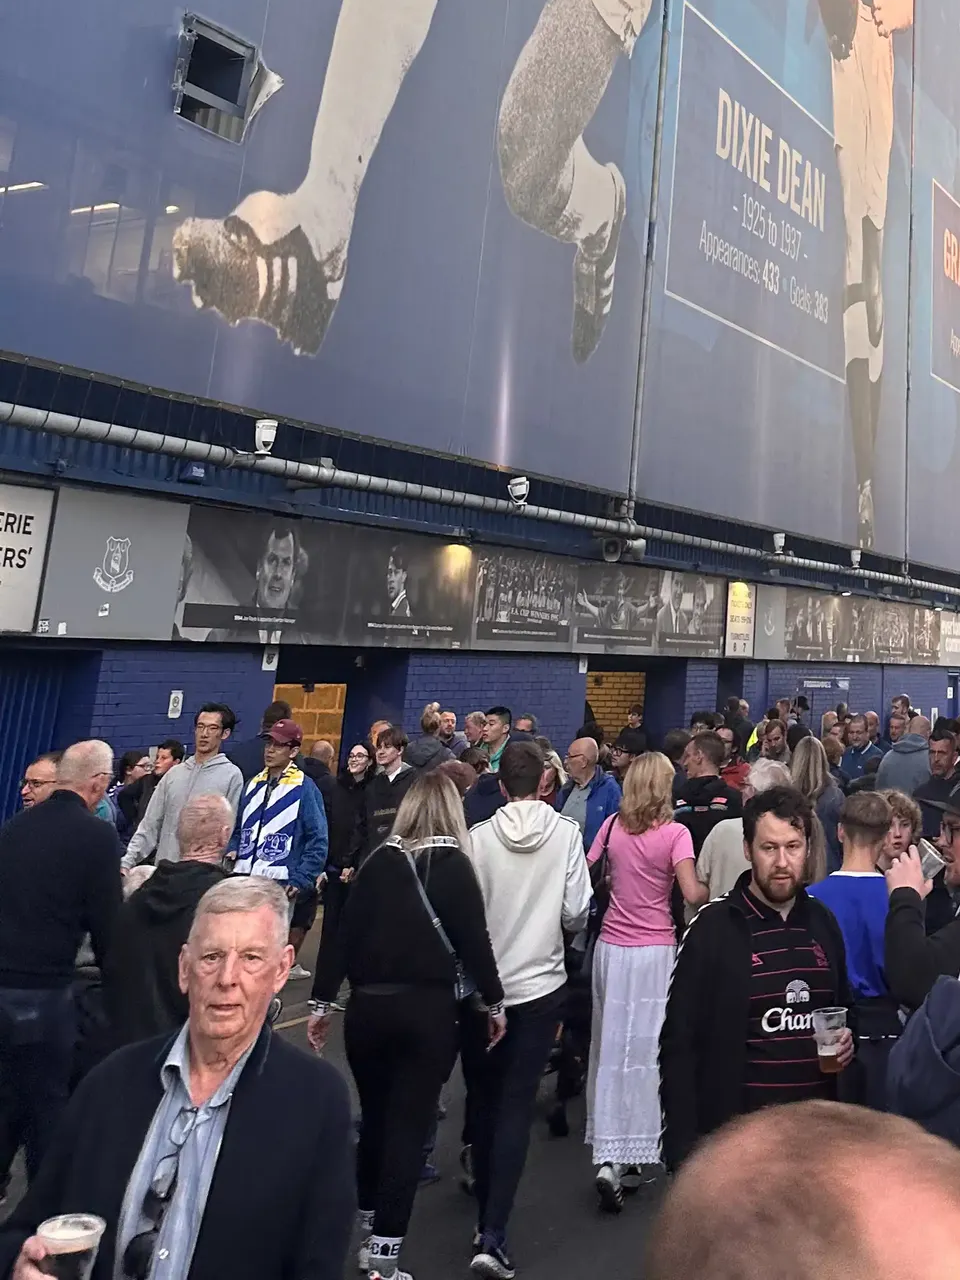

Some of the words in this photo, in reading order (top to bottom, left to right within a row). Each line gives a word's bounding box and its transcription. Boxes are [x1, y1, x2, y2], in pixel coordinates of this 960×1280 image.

[716, 87, 773, 193] DIXIE
[777, 137, 826, 232] DEAN
[699, 220, 761, 284] Appearances:
[762, 258, 780, 295] 433
[789, 275, 813, 315] Goals:
[741, 193, 766, 239] 1925
[768, 212, 777, 247] to
[780, 220, 801, 262] 1937
[0, 547, 32, 569] RS'
